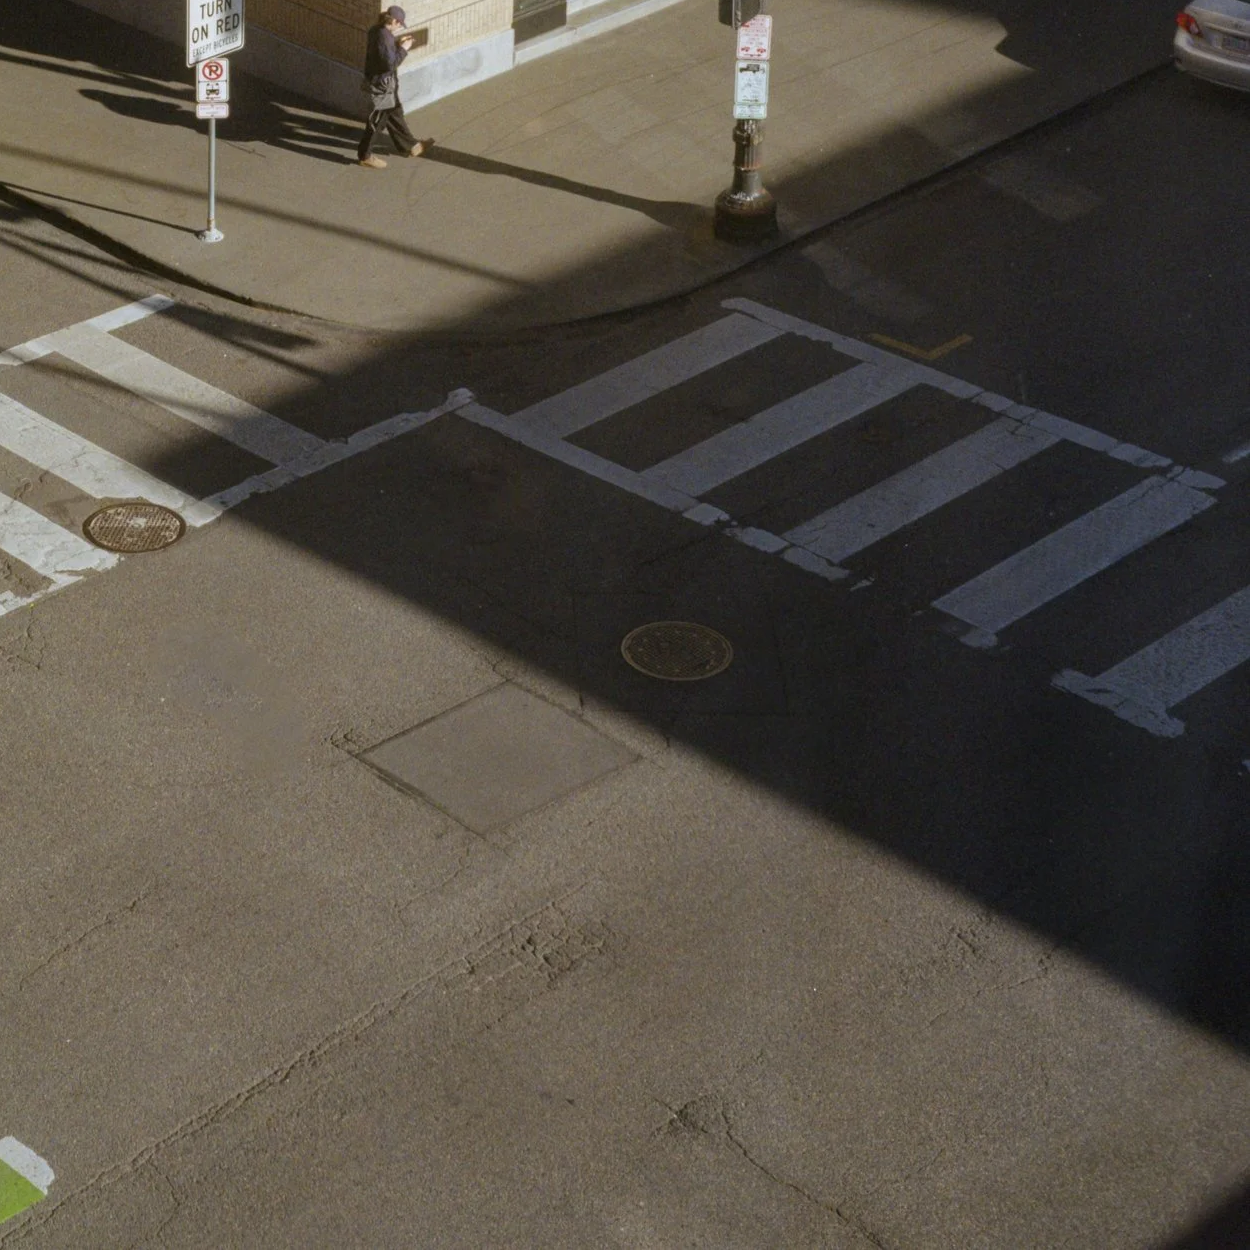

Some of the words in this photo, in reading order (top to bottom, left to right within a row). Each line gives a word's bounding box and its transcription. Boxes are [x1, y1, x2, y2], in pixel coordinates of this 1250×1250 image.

[192, 24, 208, 44] ON
[216, 13, 240, 35] RED
[193, 42, 211, 57] EXCEPT
[213, 33, 239, 50] BICYCLES
